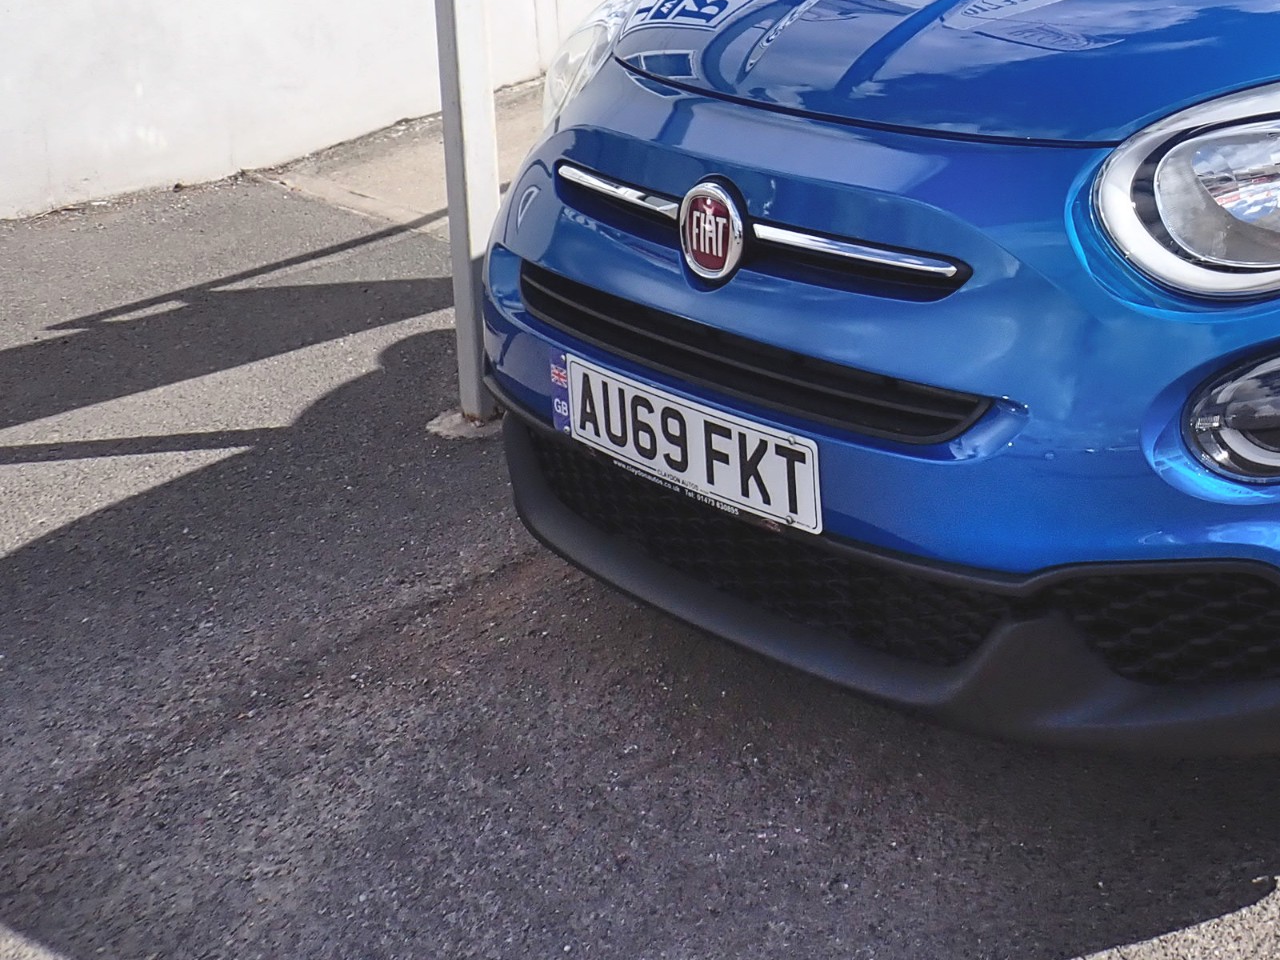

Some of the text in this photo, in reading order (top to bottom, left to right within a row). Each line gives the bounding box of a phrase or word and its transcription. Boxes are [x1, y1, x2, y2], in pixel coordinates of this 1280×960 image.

[692, 208, 728, 258] FIAT
[553, 397, 569, 416] GB
[579, 371, 806, 514] AU69 FKT
